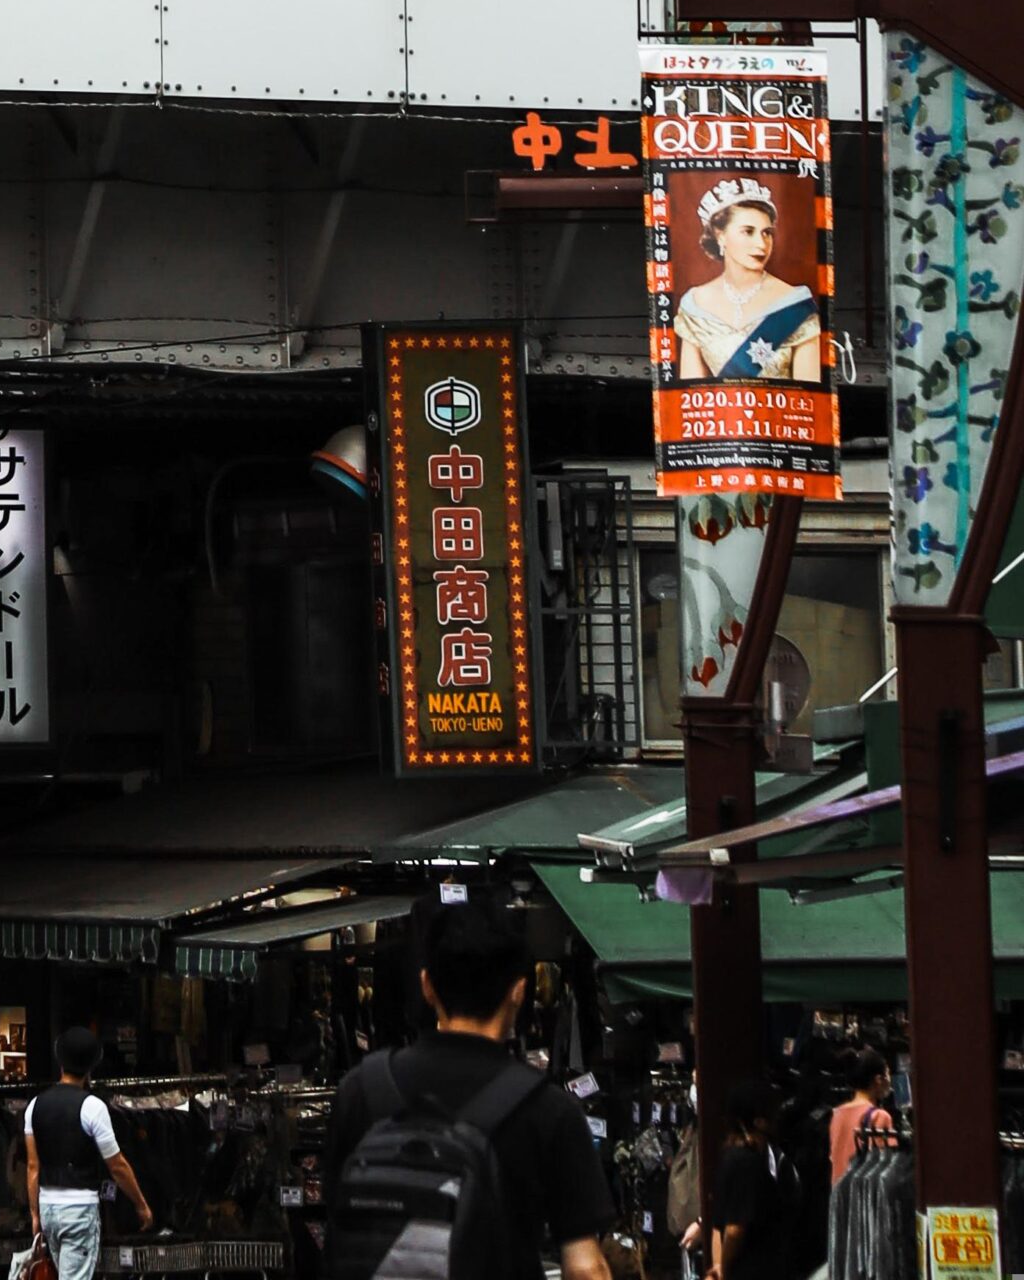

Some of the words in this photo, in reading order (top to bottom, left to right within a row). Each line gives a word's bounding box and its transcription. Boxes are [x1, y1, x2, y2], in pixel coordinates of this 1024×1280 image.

[654, 121, 817, 155] QUEEN
[681, 391, 787, 409] 2020.10.10
[682, 420, 772, 438] 2021.1.11
[668, 453, 783, 468] www.kingandqueen.jp
[695, 474, 805, 490] 上野の森美術館
[428, 444, 493, 687] 中田商店
[428, 692, 503, 714] NAKATA
[430, 717, 504, 733] TOKYO-UENO
